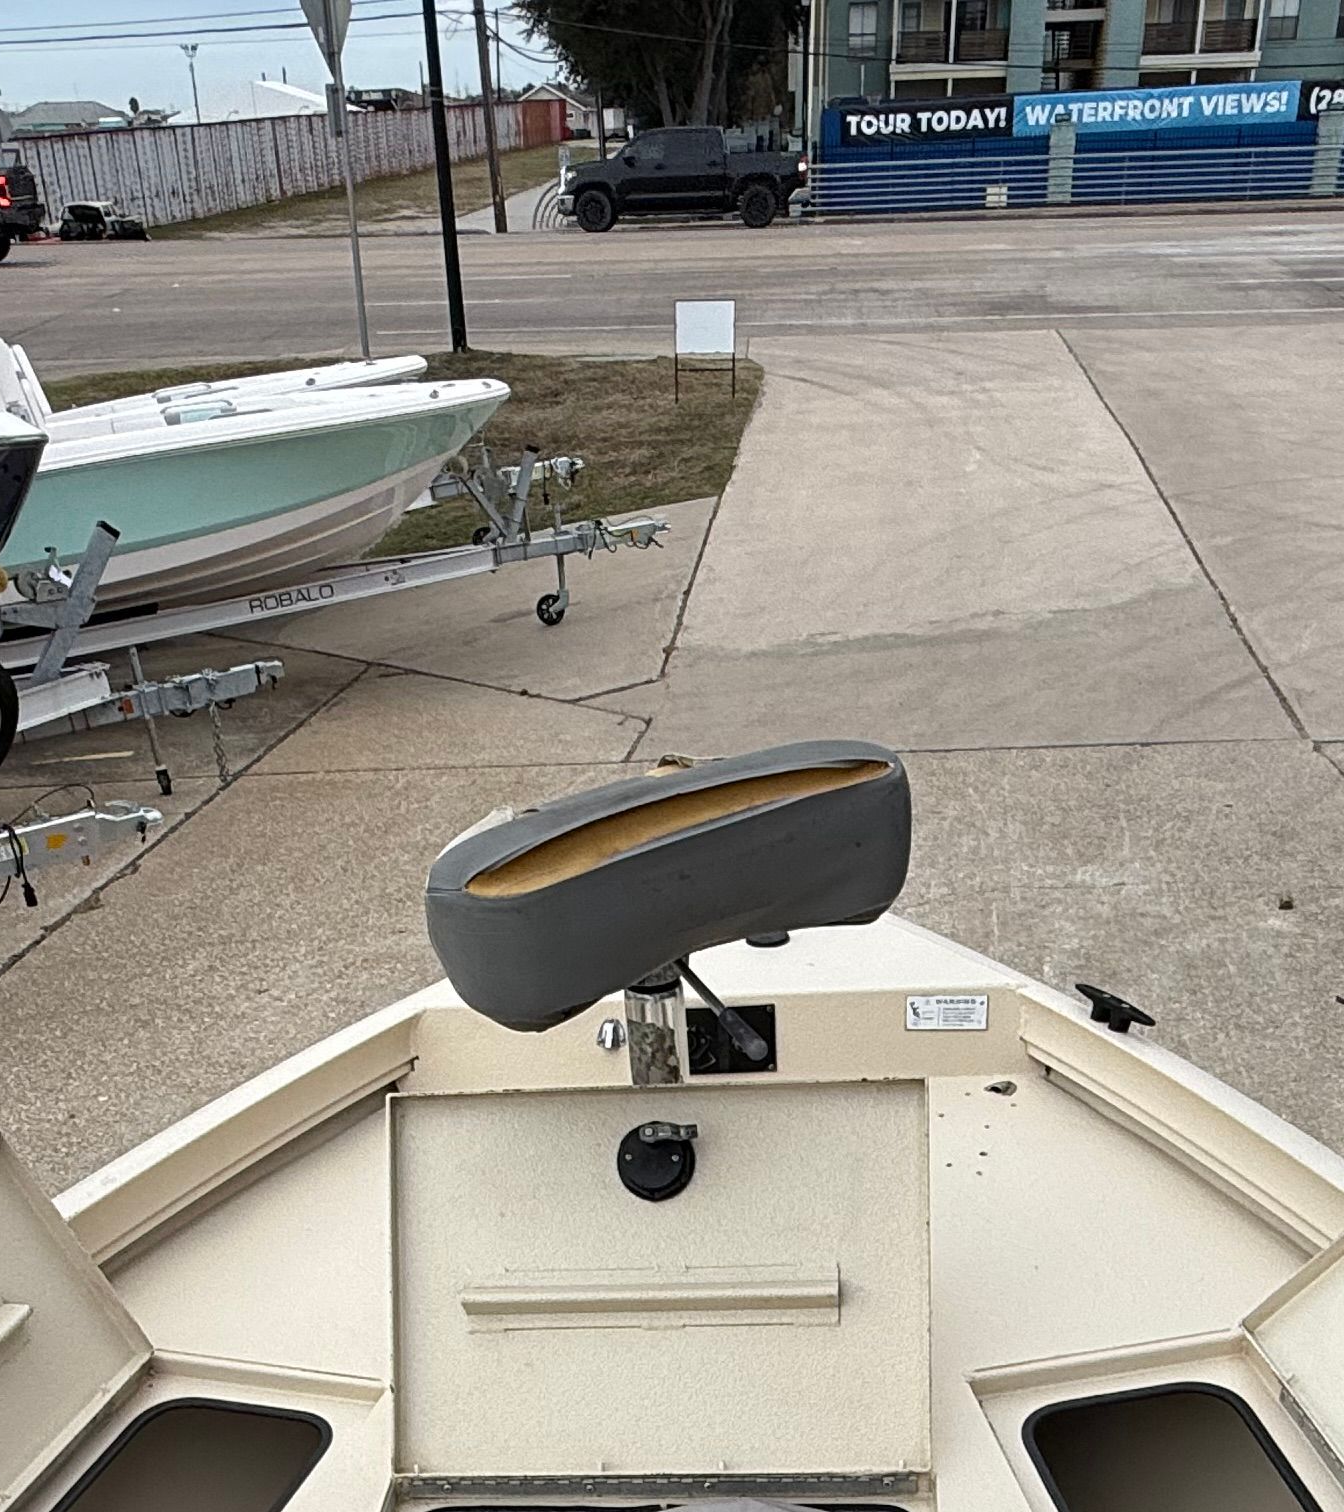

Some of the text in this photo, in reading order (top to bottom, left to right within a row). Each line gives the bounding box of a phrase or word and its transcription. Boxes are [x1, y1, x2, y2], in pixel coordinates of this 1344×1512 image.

[845, 113, 912, 137] TOUR
[920, 106, 1007, 133] TODAY!
[1024, 96, 1194, 126] WATERFRONT
[1200, 91, 1288, 116] VIEWS!
[249, 584, 335, 615] ROBALO
